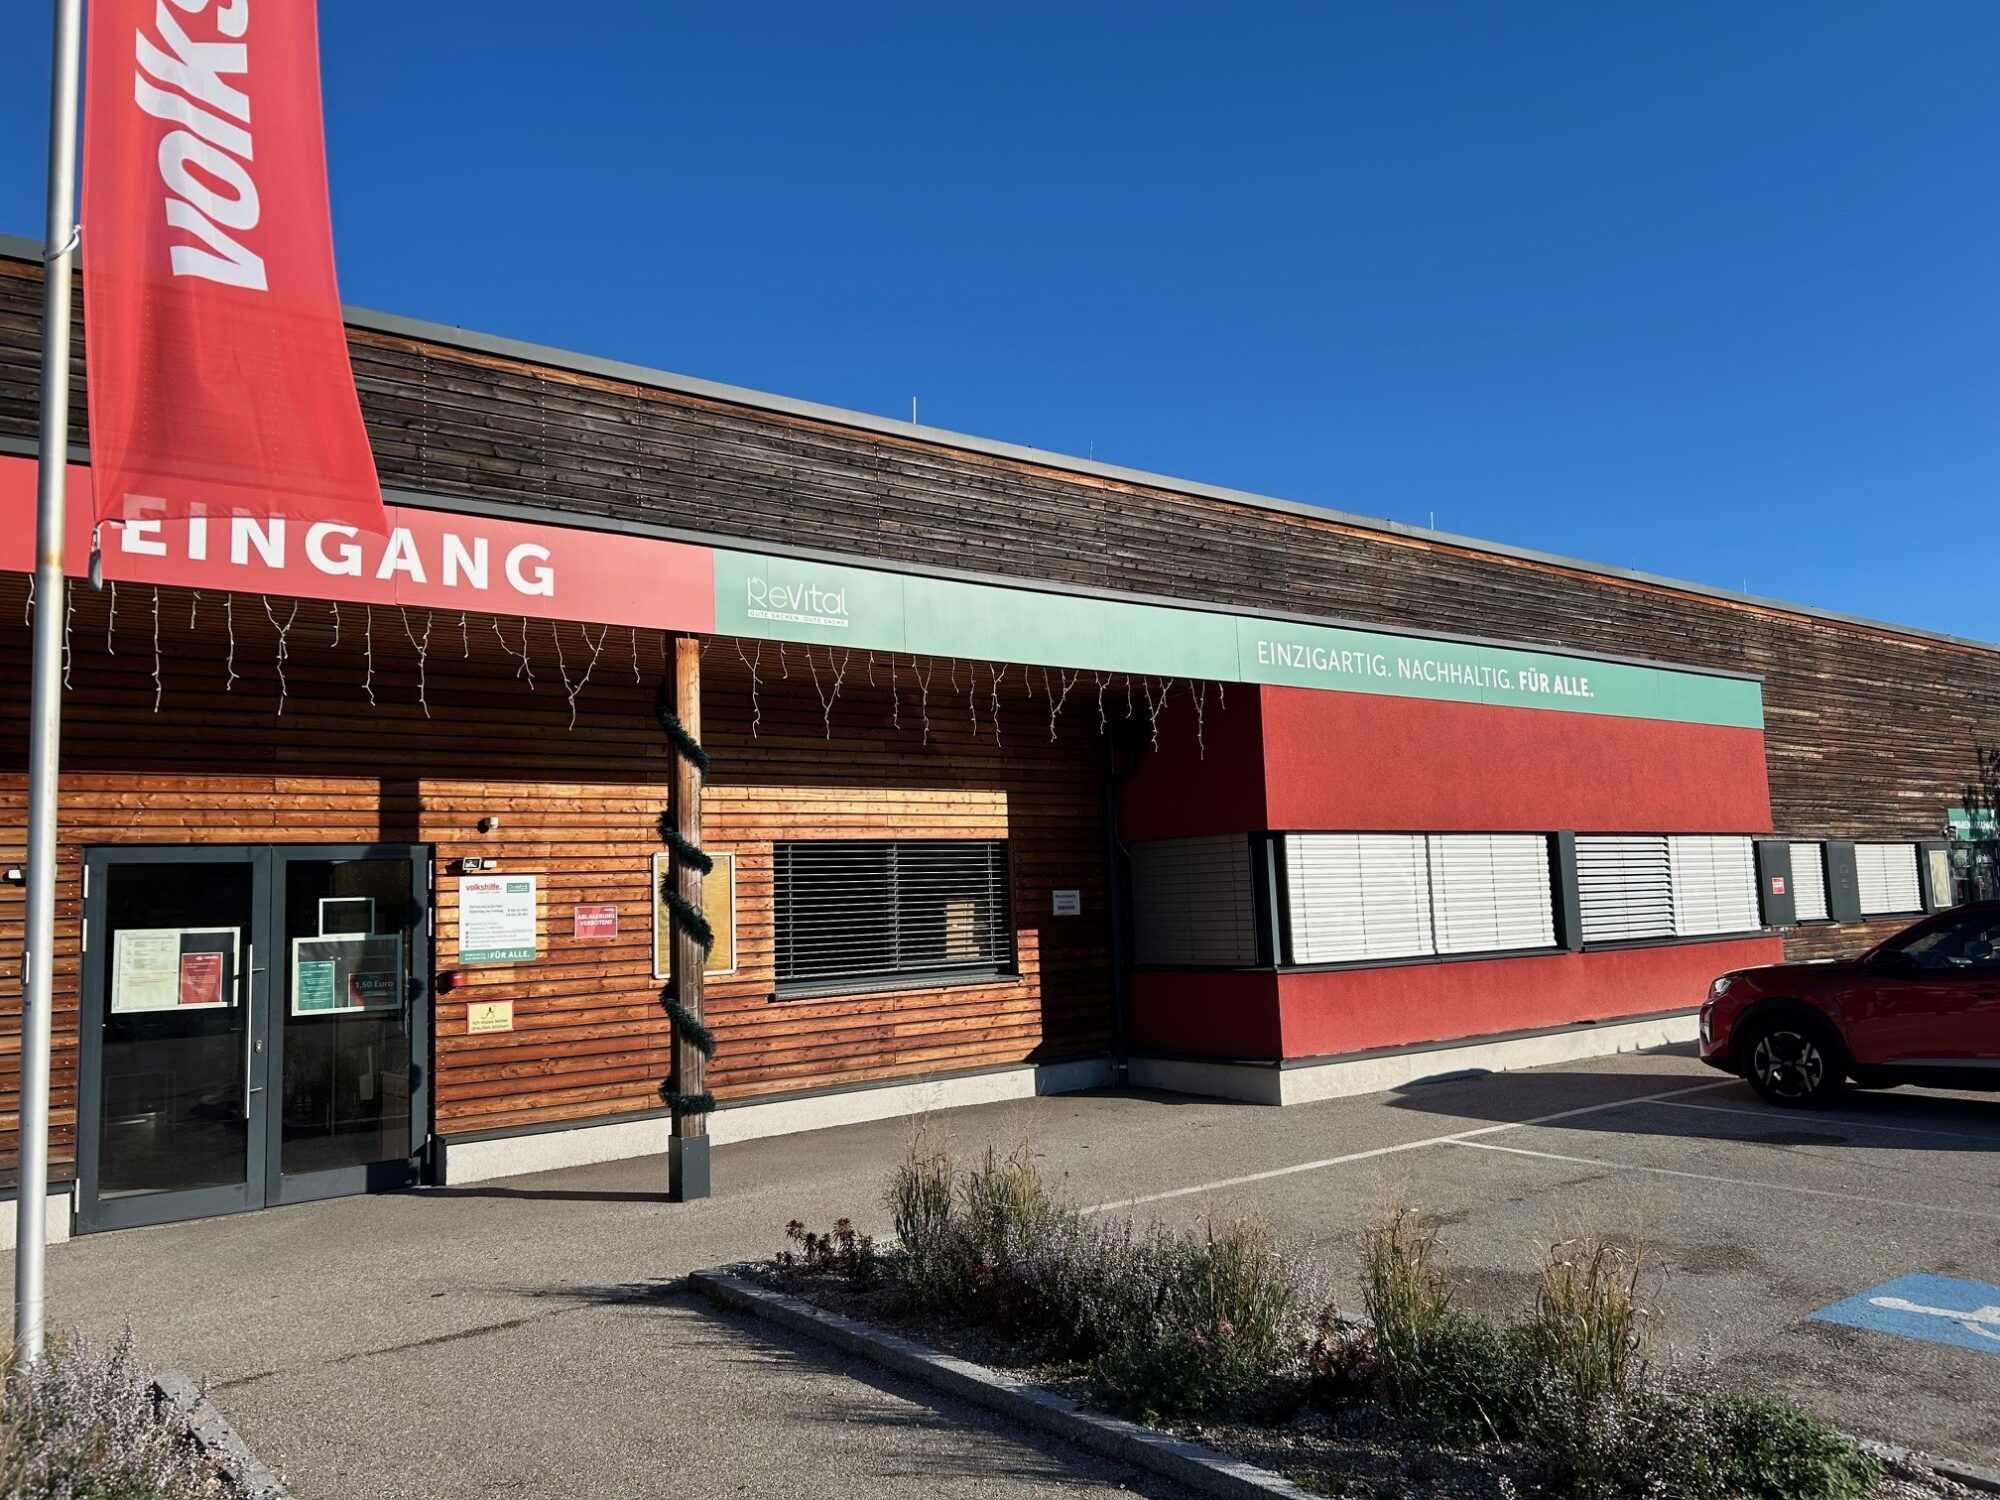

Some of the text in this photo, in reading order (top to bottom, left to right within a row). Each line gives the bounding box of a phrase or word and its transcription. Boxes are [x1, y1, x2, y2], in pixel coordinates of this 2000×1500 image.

[120, 493, 555, 598] EINGANG
[746, 576, 849, 616] ReVital
[1257, 640, 1595, 698] EINZIGARTIG. NACHHALTIG. FÜR ALLE.
[490, 950, 507, 960] FÜR
[508, 950, 531, 959] ALLE.
[355, 980, 394, 989] 1,50 Euro
